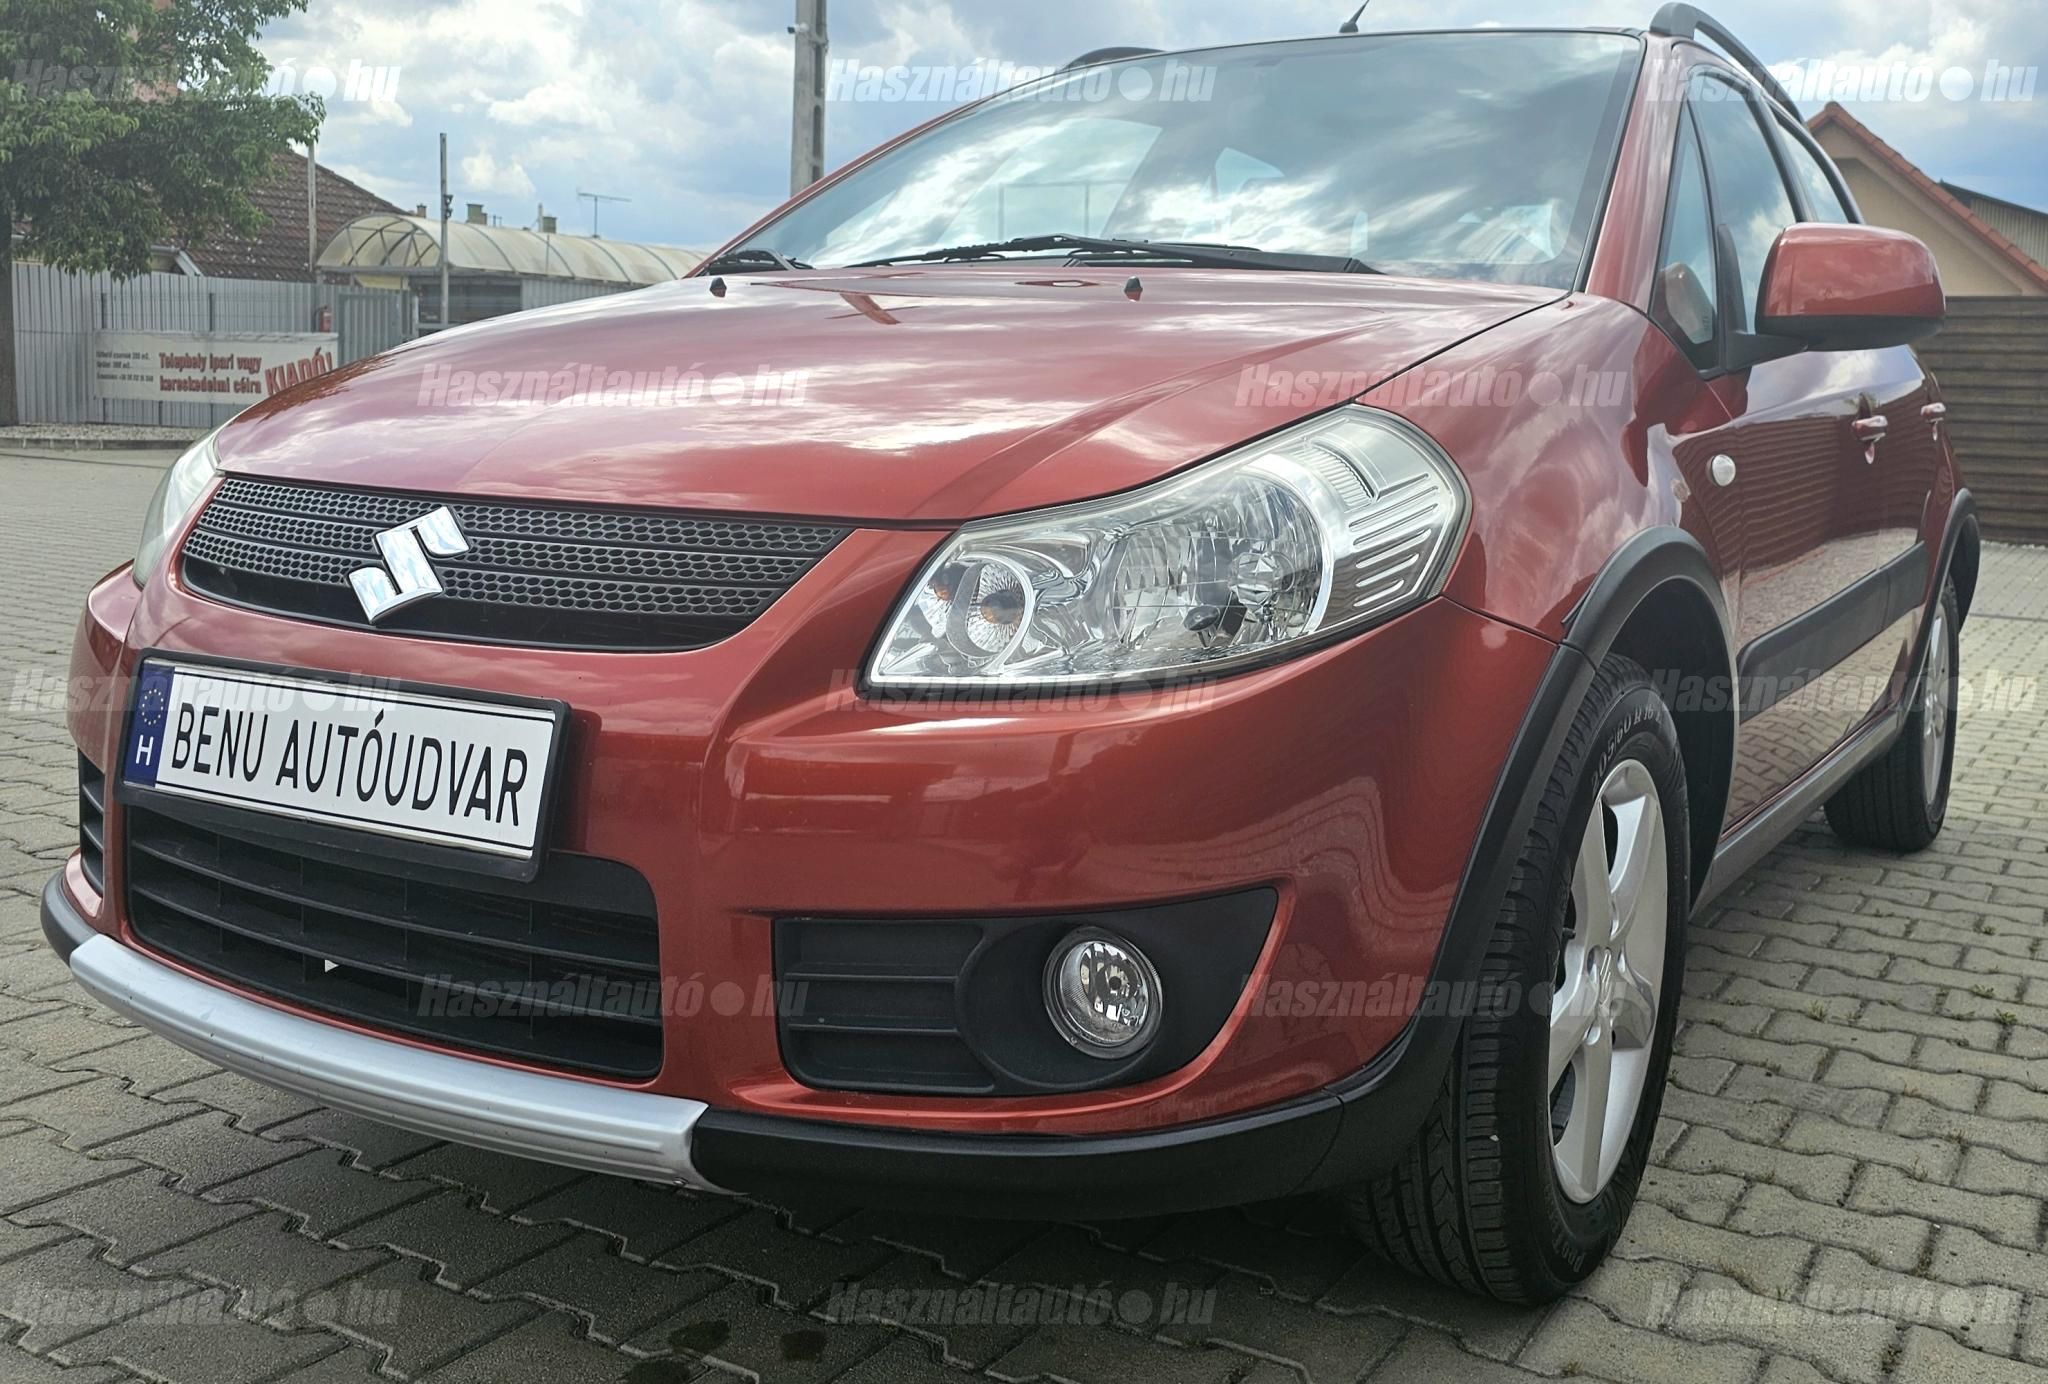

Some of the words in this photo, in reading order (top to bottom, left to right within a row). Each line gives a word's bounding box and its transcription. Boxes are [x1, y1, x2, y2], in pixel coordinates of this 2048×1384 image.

[158, 352, 207, 373] Telephely
[237, 357, 262, 375] vagy
[159, 375, 230, 393] kereskedelmi
[233, 376, 262, 394] célra
[135, 734, 154, 766] H
[171, 702, 270, 783] BENU
[275, 709, 529, 827] AUTÓUDVAR
